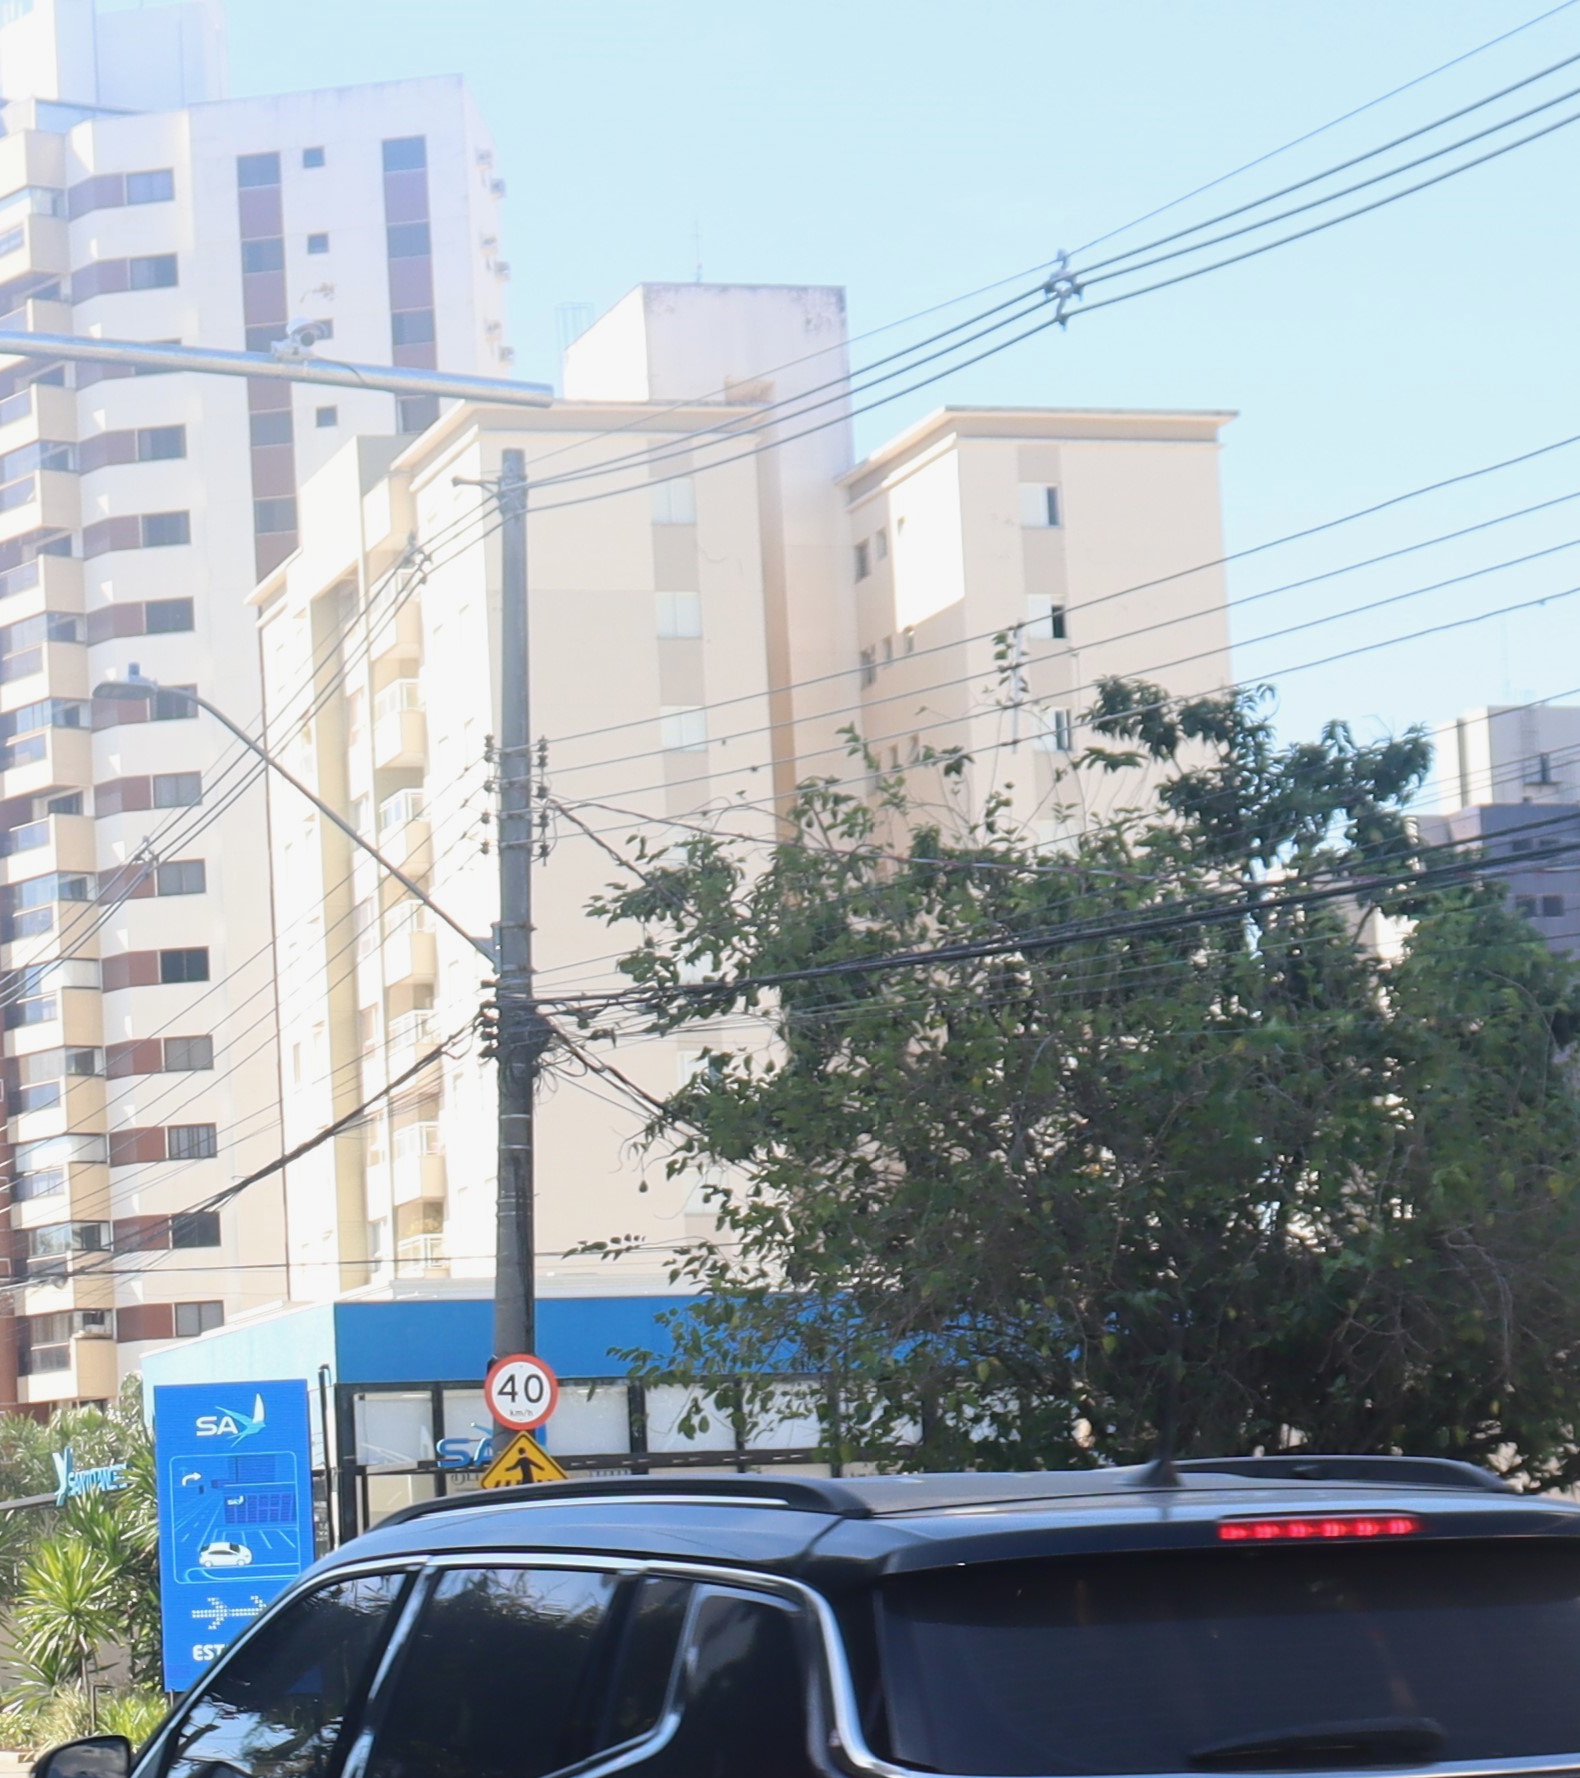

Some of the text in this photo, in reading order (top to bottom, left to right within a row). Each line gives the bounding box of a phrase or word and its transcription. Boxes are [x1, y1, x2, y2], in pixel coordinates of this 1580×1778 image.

[497, 1373, 544, 1404] 40
[509, 1408, 534, 1417] km/h
[192, 1643, 228, 1661] EST
